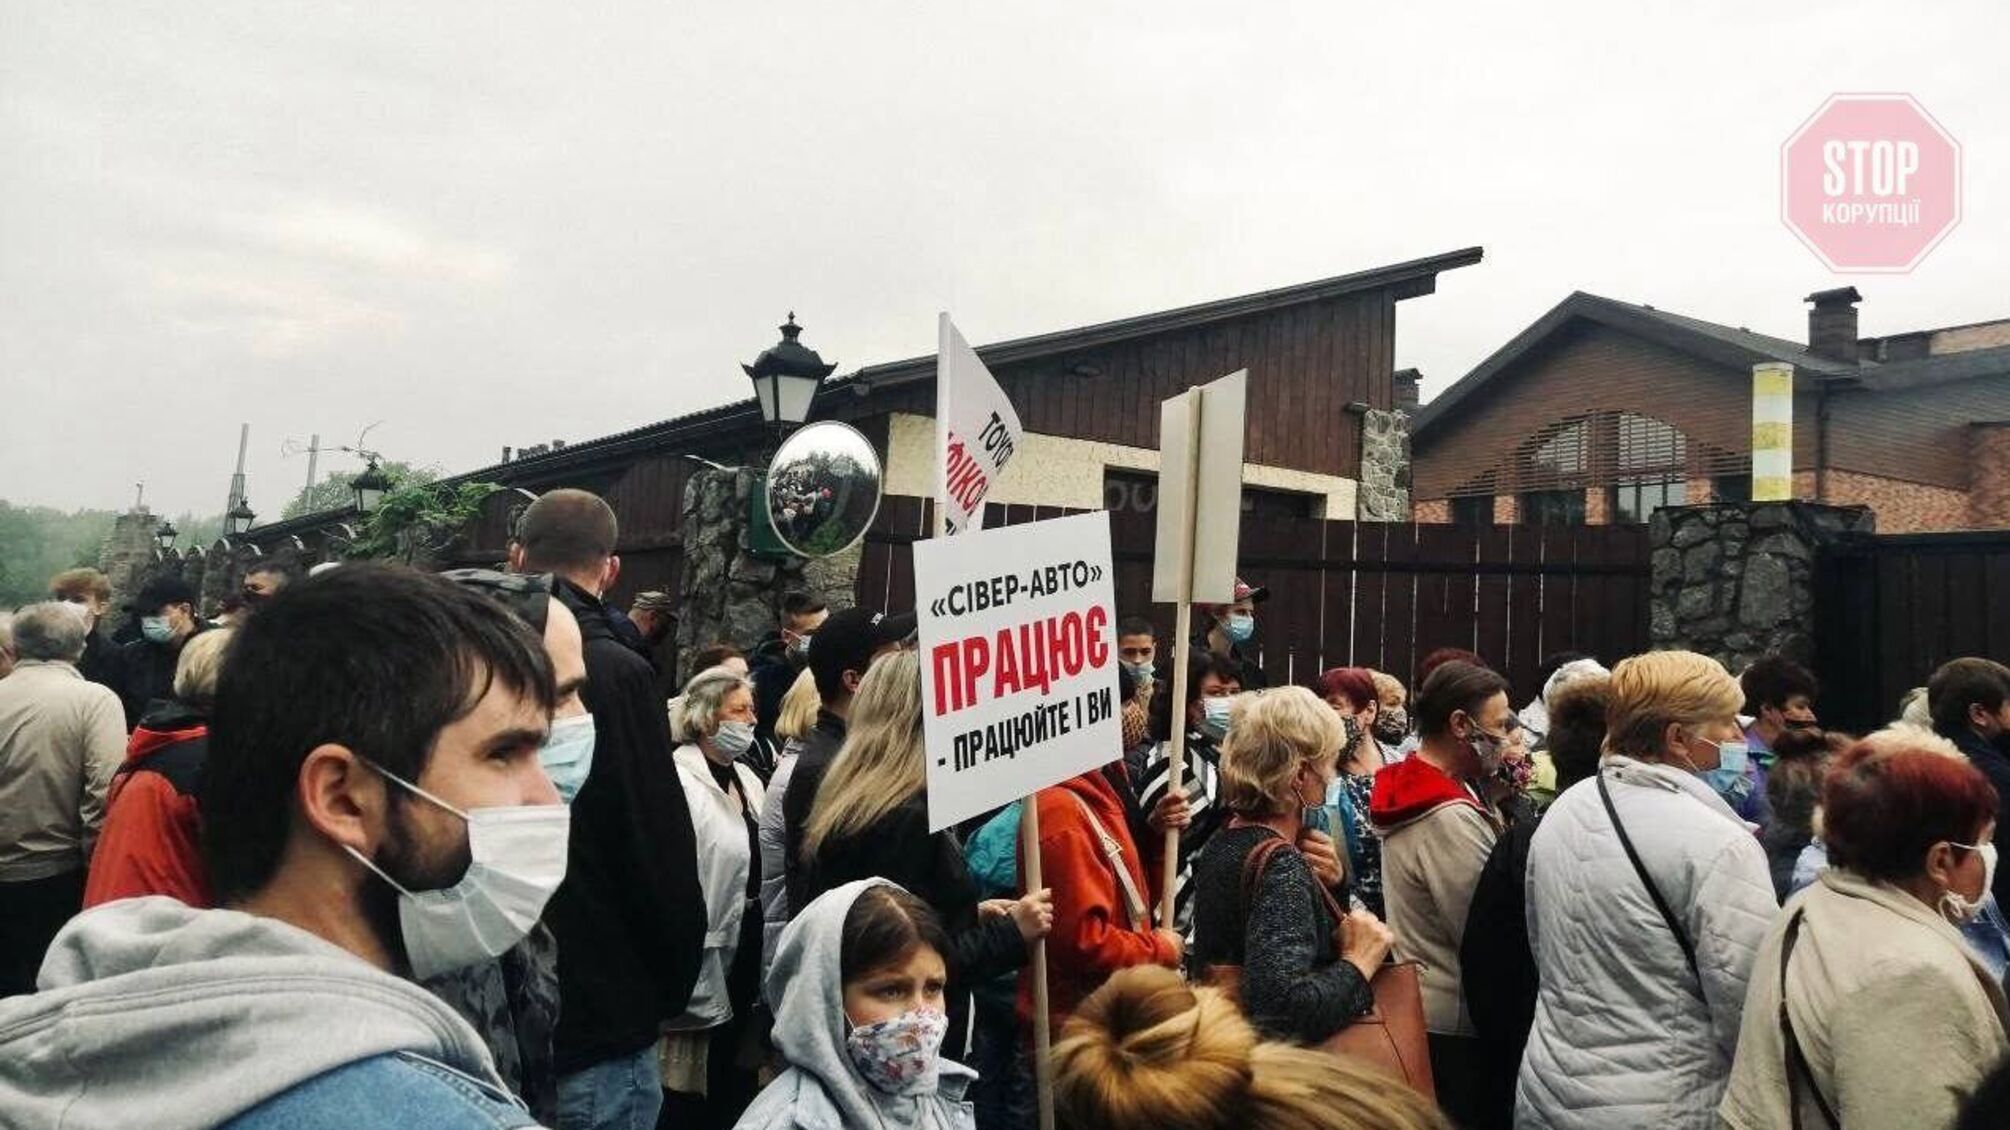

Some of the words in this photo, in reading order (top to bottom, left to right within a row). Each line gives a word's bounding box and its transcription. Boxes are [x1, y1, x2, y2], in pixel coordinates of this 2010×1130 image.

[978, 410, 1014, 475] TOYO
[930, 560, 1103, 617] «СІВЕР-АВТО»
[931, 605, 1109, 716] ПРАЦЮЄ
[953, 700, 1070, 772] ПРАЦЮЙТЕ
[1075, 696, 1082, 730] І
[1087, 686, 1112, 724] ВИ
